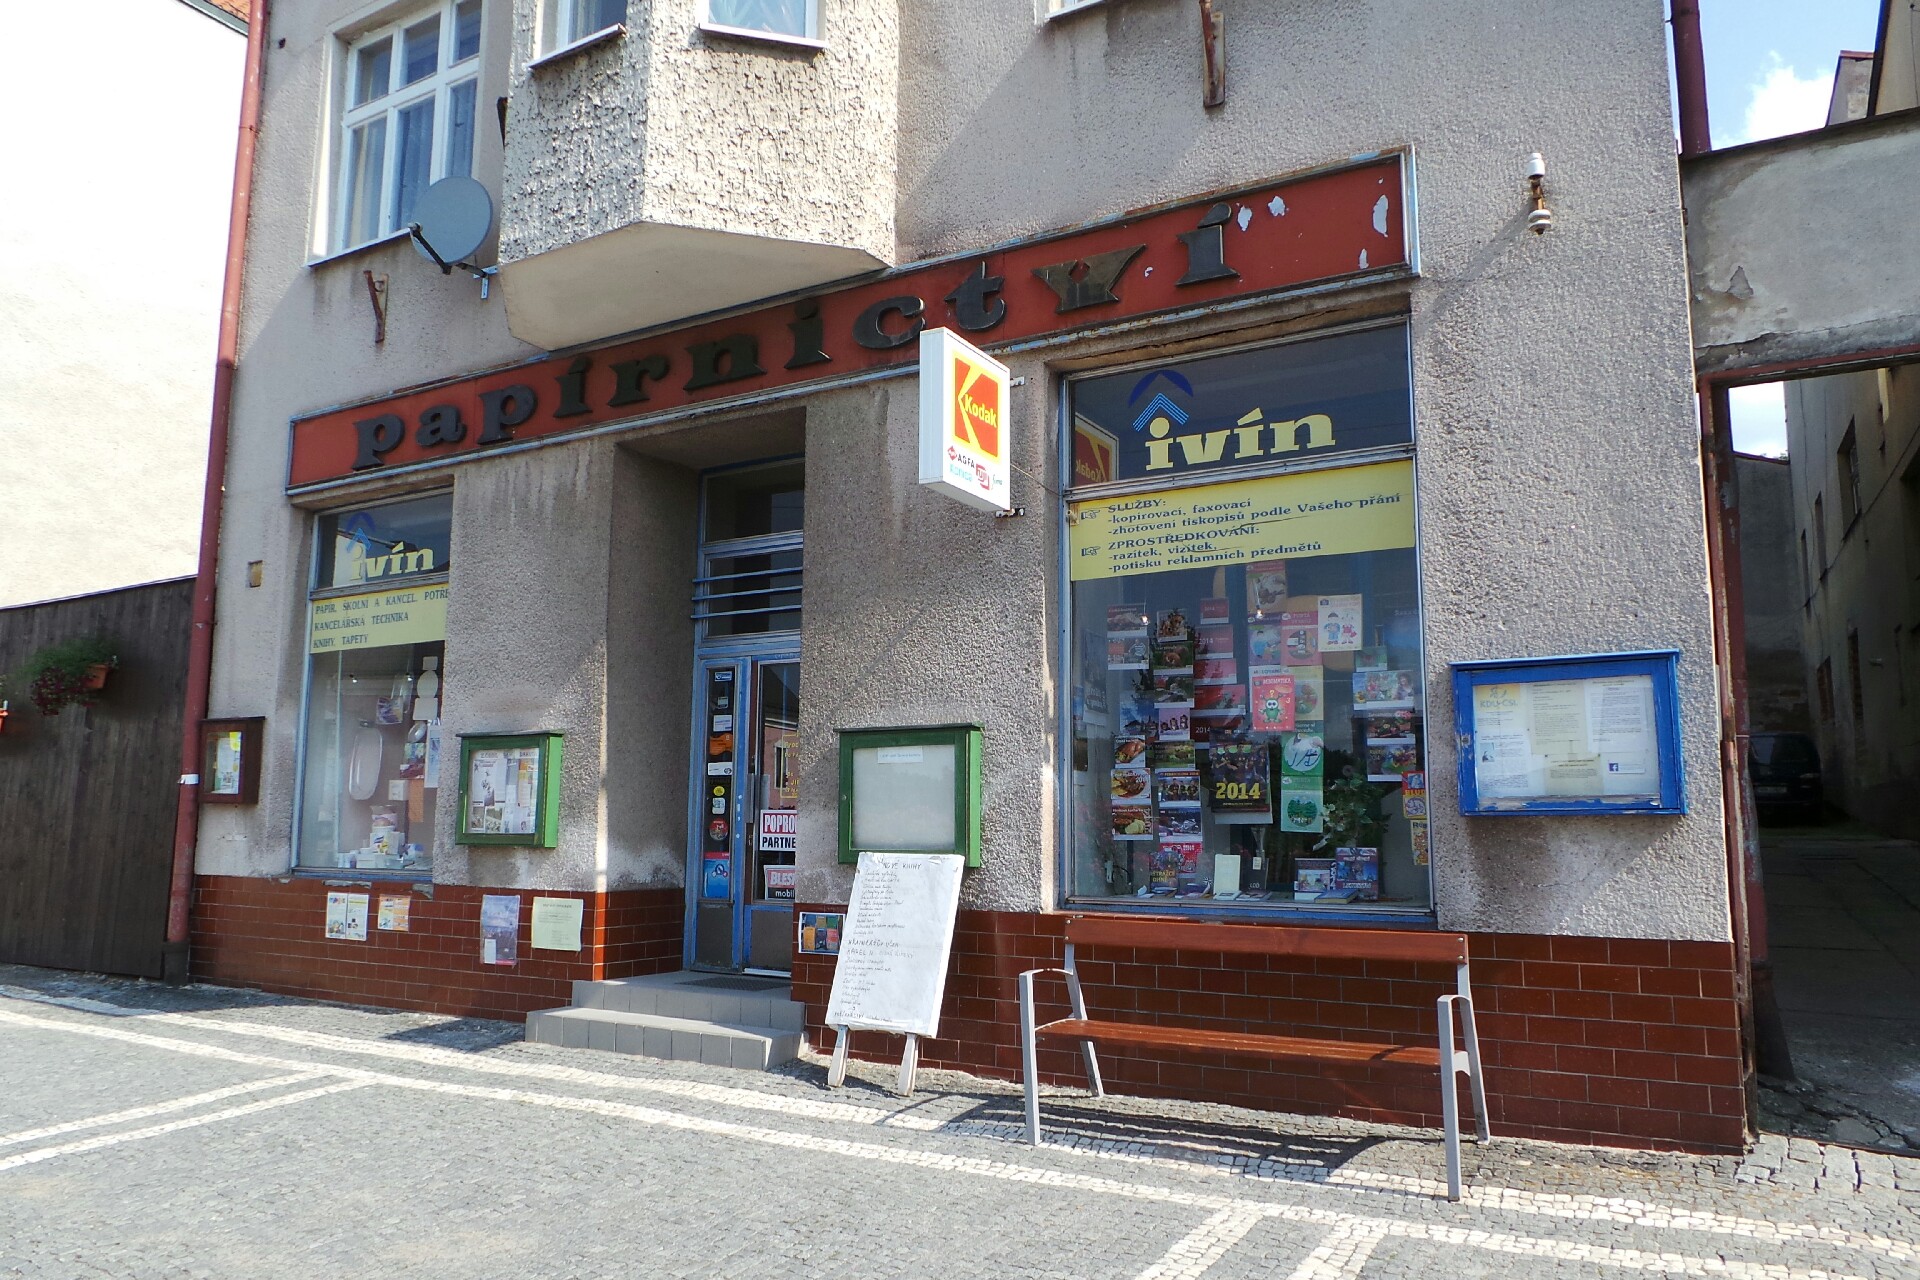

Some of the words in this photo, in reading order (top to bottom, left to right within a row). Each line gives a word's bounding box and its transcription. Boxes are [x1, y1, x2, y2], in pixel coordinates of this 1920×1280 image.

[351, 203, 1241, 471] papírnictví
[963, 393, 998, 429] Kodak
[1144, 407, 1336, 471] ivín
[957, 453, 975, 469] AGFA
[1107, 499, 1166, 513] SLUŽBY:
[1107, 519, 1176, 536] -zhotovení
[1182, 510, 1245, 528] tiskopisů
[1250, 506, 1291, 521] podle
[1297, 499, 1353, 514] Vašeho
[1359, 492, 1401, 510] přání
[1192, 498, 1252, 514] faxovací
[1107, 523, 1260, 551] ZPROSTŘEDKOVÁNÍ:
[349, 540, 434, 581] ivín
[1108, 547, 1163, 561] -razítek,
[1108, 556, 1161, 573] -potisku
[1166, 549, 1245, 566] reklamních
[1250, 541, 1321, 559] předmětů
[374, 597, 380, 608] A
[371, 611, 409, 626] TECHNIKA
[342, 633, 369, 646] TAPETY
[1215, 782, 1261, 800] 2014
